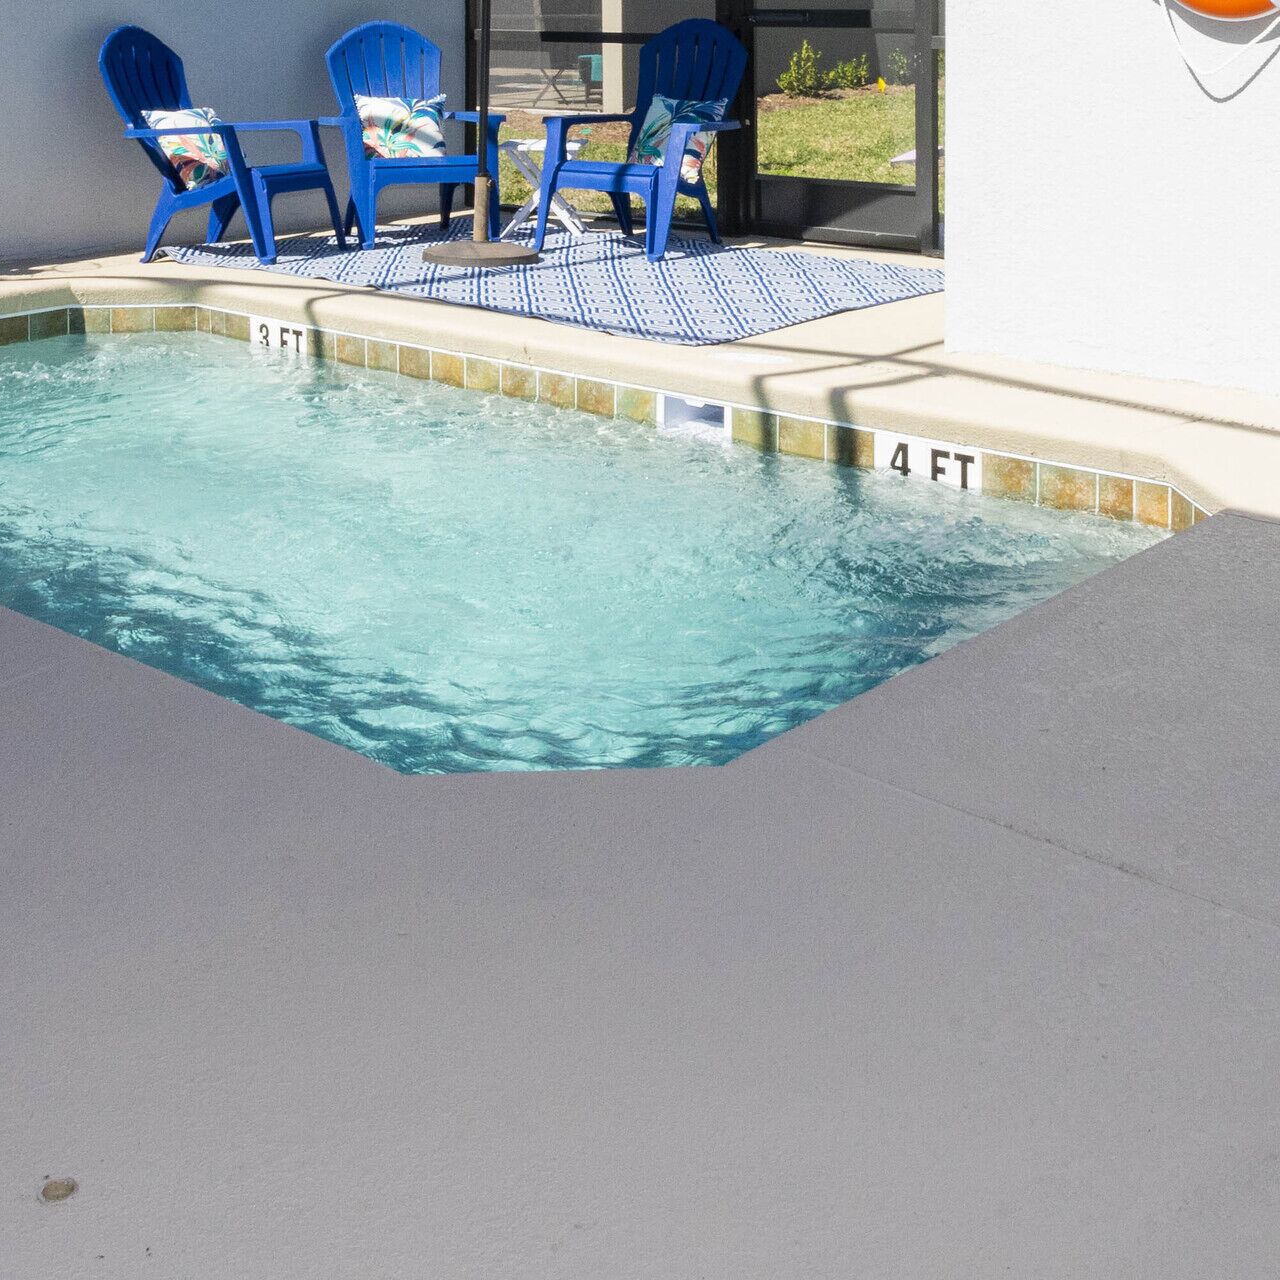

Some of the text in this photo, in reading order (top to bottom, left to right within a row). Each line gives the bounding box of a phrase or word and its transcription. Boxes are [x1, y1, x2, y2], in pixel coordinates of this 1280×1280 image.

[259, 323, 303, 353] 3 FT
[890, 442, 974, 489] 4 FT
